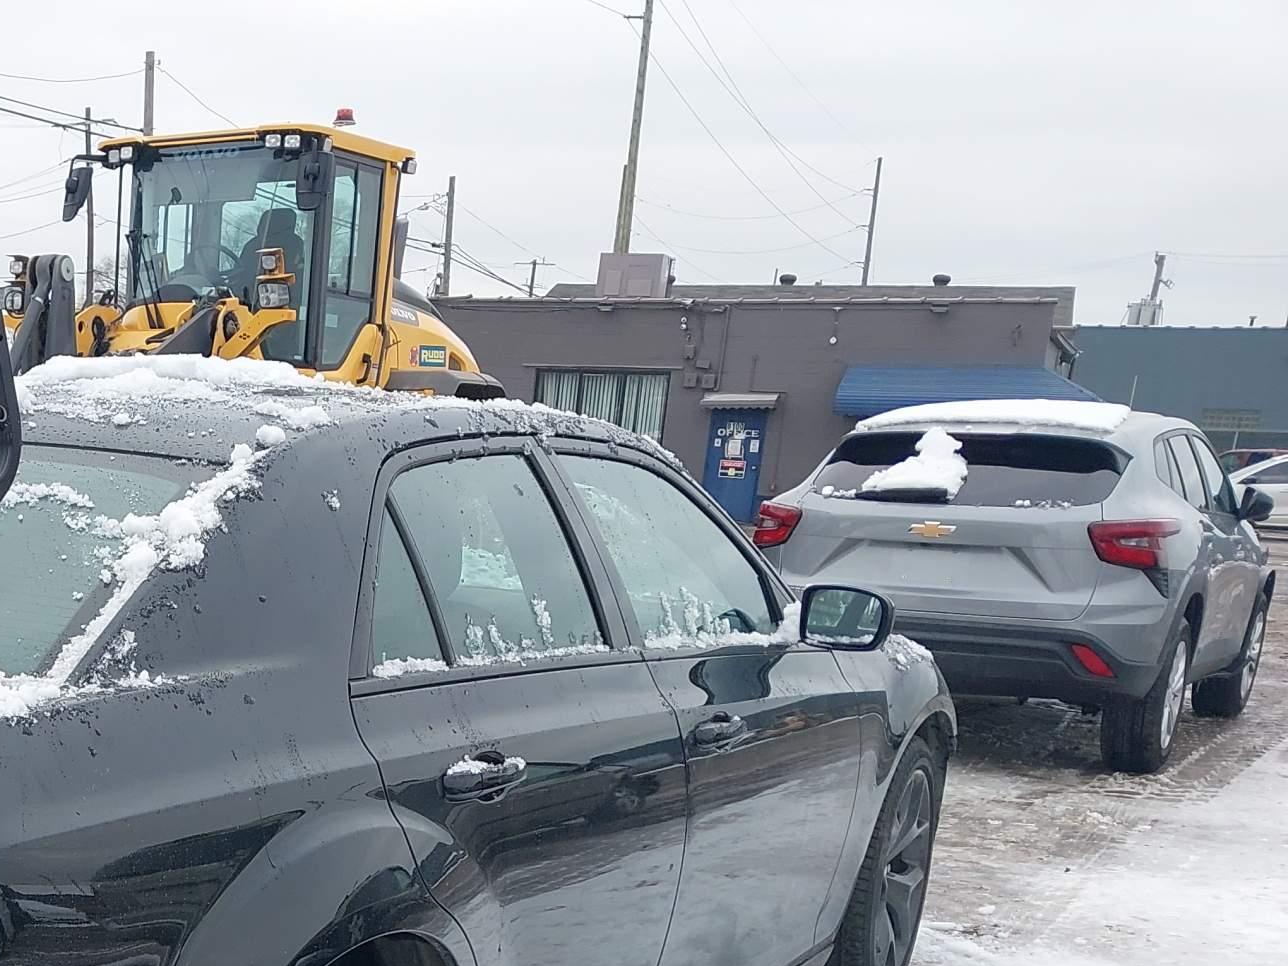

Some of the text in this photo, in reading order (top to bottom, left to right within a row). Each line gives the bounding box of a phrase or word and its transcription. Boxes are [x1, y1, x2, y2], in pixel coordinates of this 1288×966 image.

[174, 146, 240, 161] VOLVO
[390, 306, 416, 321] OLVO
[717, 427, 760, 438] OFCE
